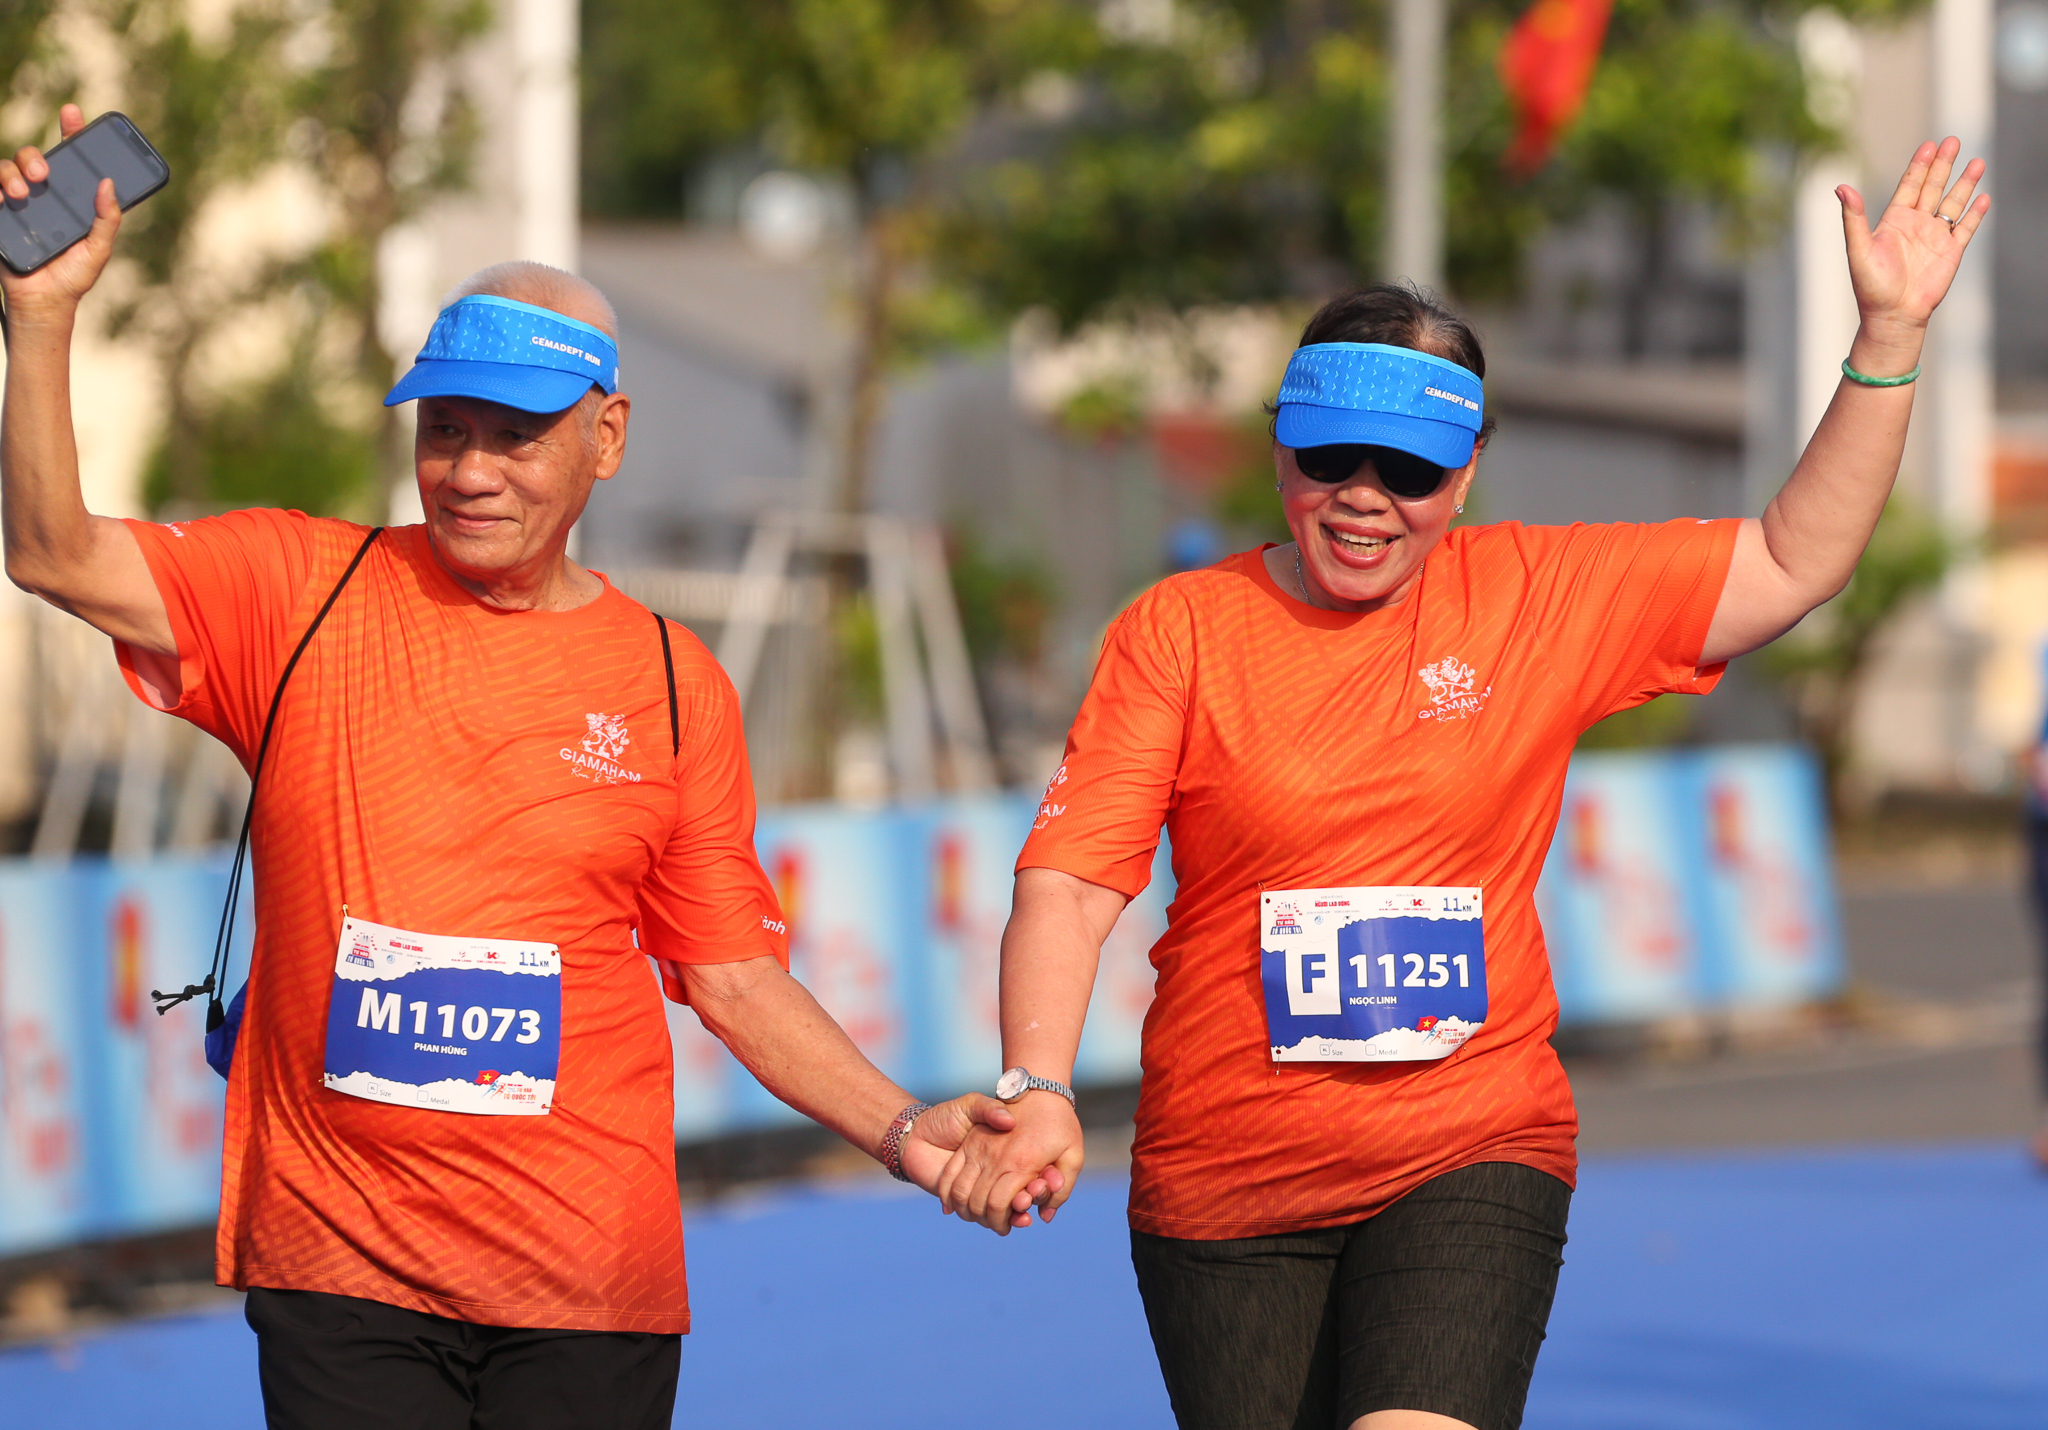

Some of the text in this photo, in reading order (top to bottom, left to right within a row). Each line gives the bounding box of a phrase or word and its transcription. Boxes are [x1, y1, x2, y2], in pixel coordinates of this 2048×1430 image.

[532, 336, 601, 366] GEMADEPT RUN
[1424, 386, 1479, 411] GEMADEPT RUN
[560, 748, 641, 783] GIAMAHAM
[1301, 953, 1470, 994] F 11251
[1349, 996, 1398, 1006] NGỌC LINH
[414, 1042, 467, 1056] PHAN HÙNG
[430, 1097, 450, 1105] Medal
